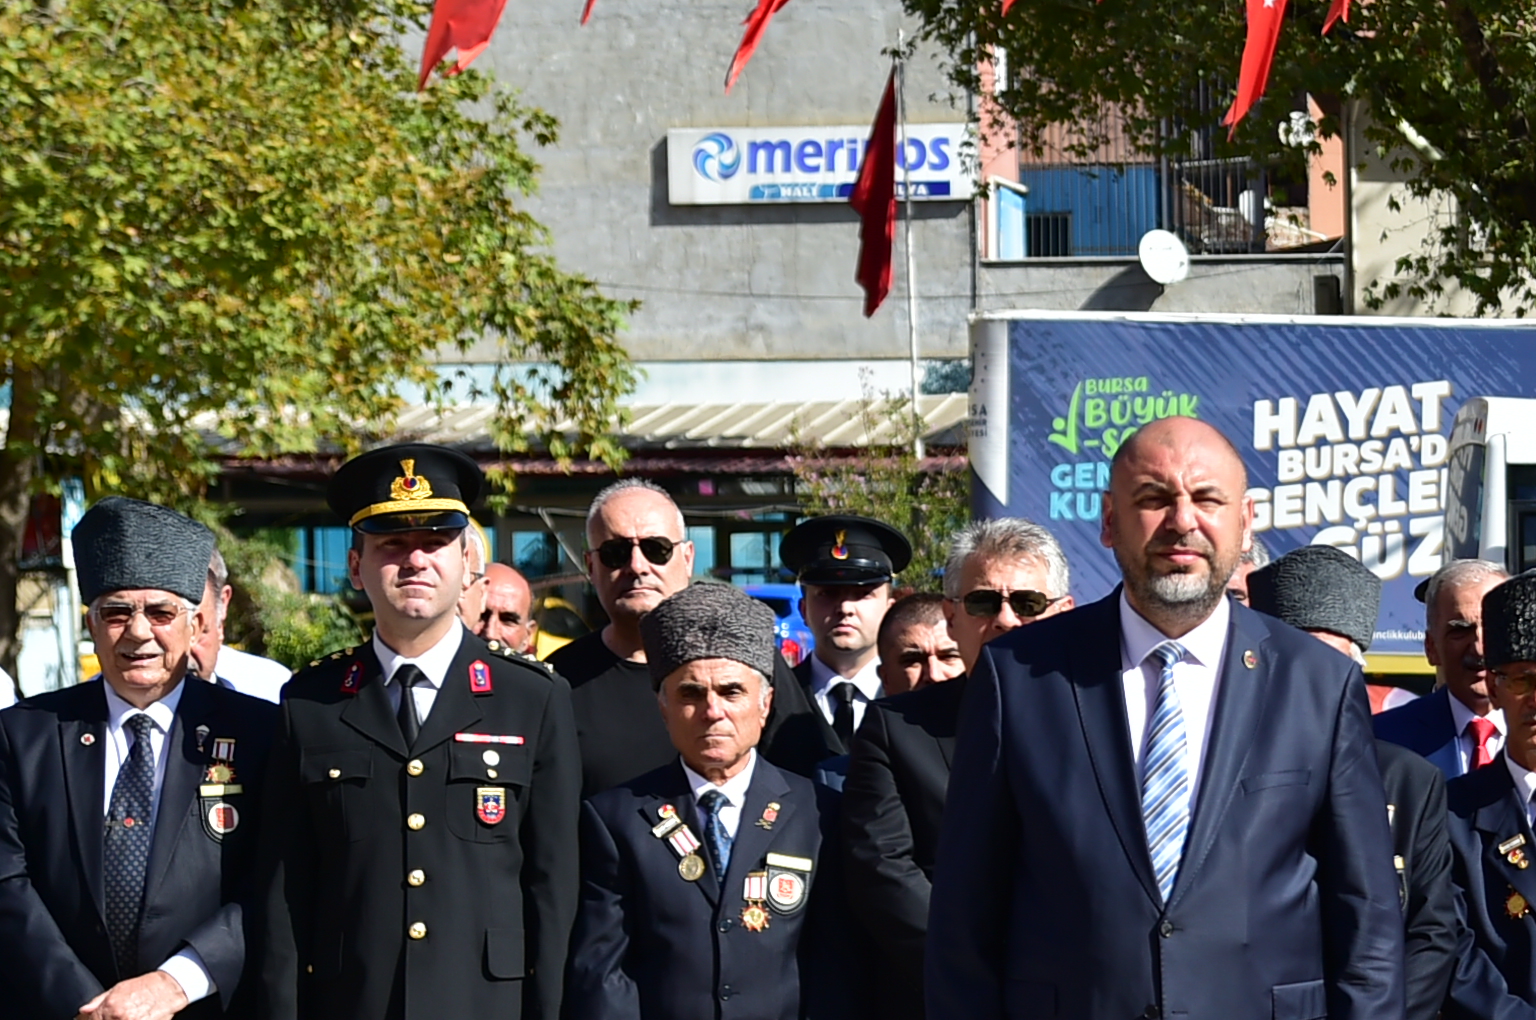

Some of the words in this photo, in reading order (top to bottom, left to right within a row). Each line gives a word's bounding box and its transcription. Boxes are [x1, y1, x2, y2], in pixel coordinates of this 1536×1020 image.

[746, 137, 950, 174] merios
[1253, 380, 1449, 450] HAYAT
[1278, 434, 1448, 482] BURSA'D
